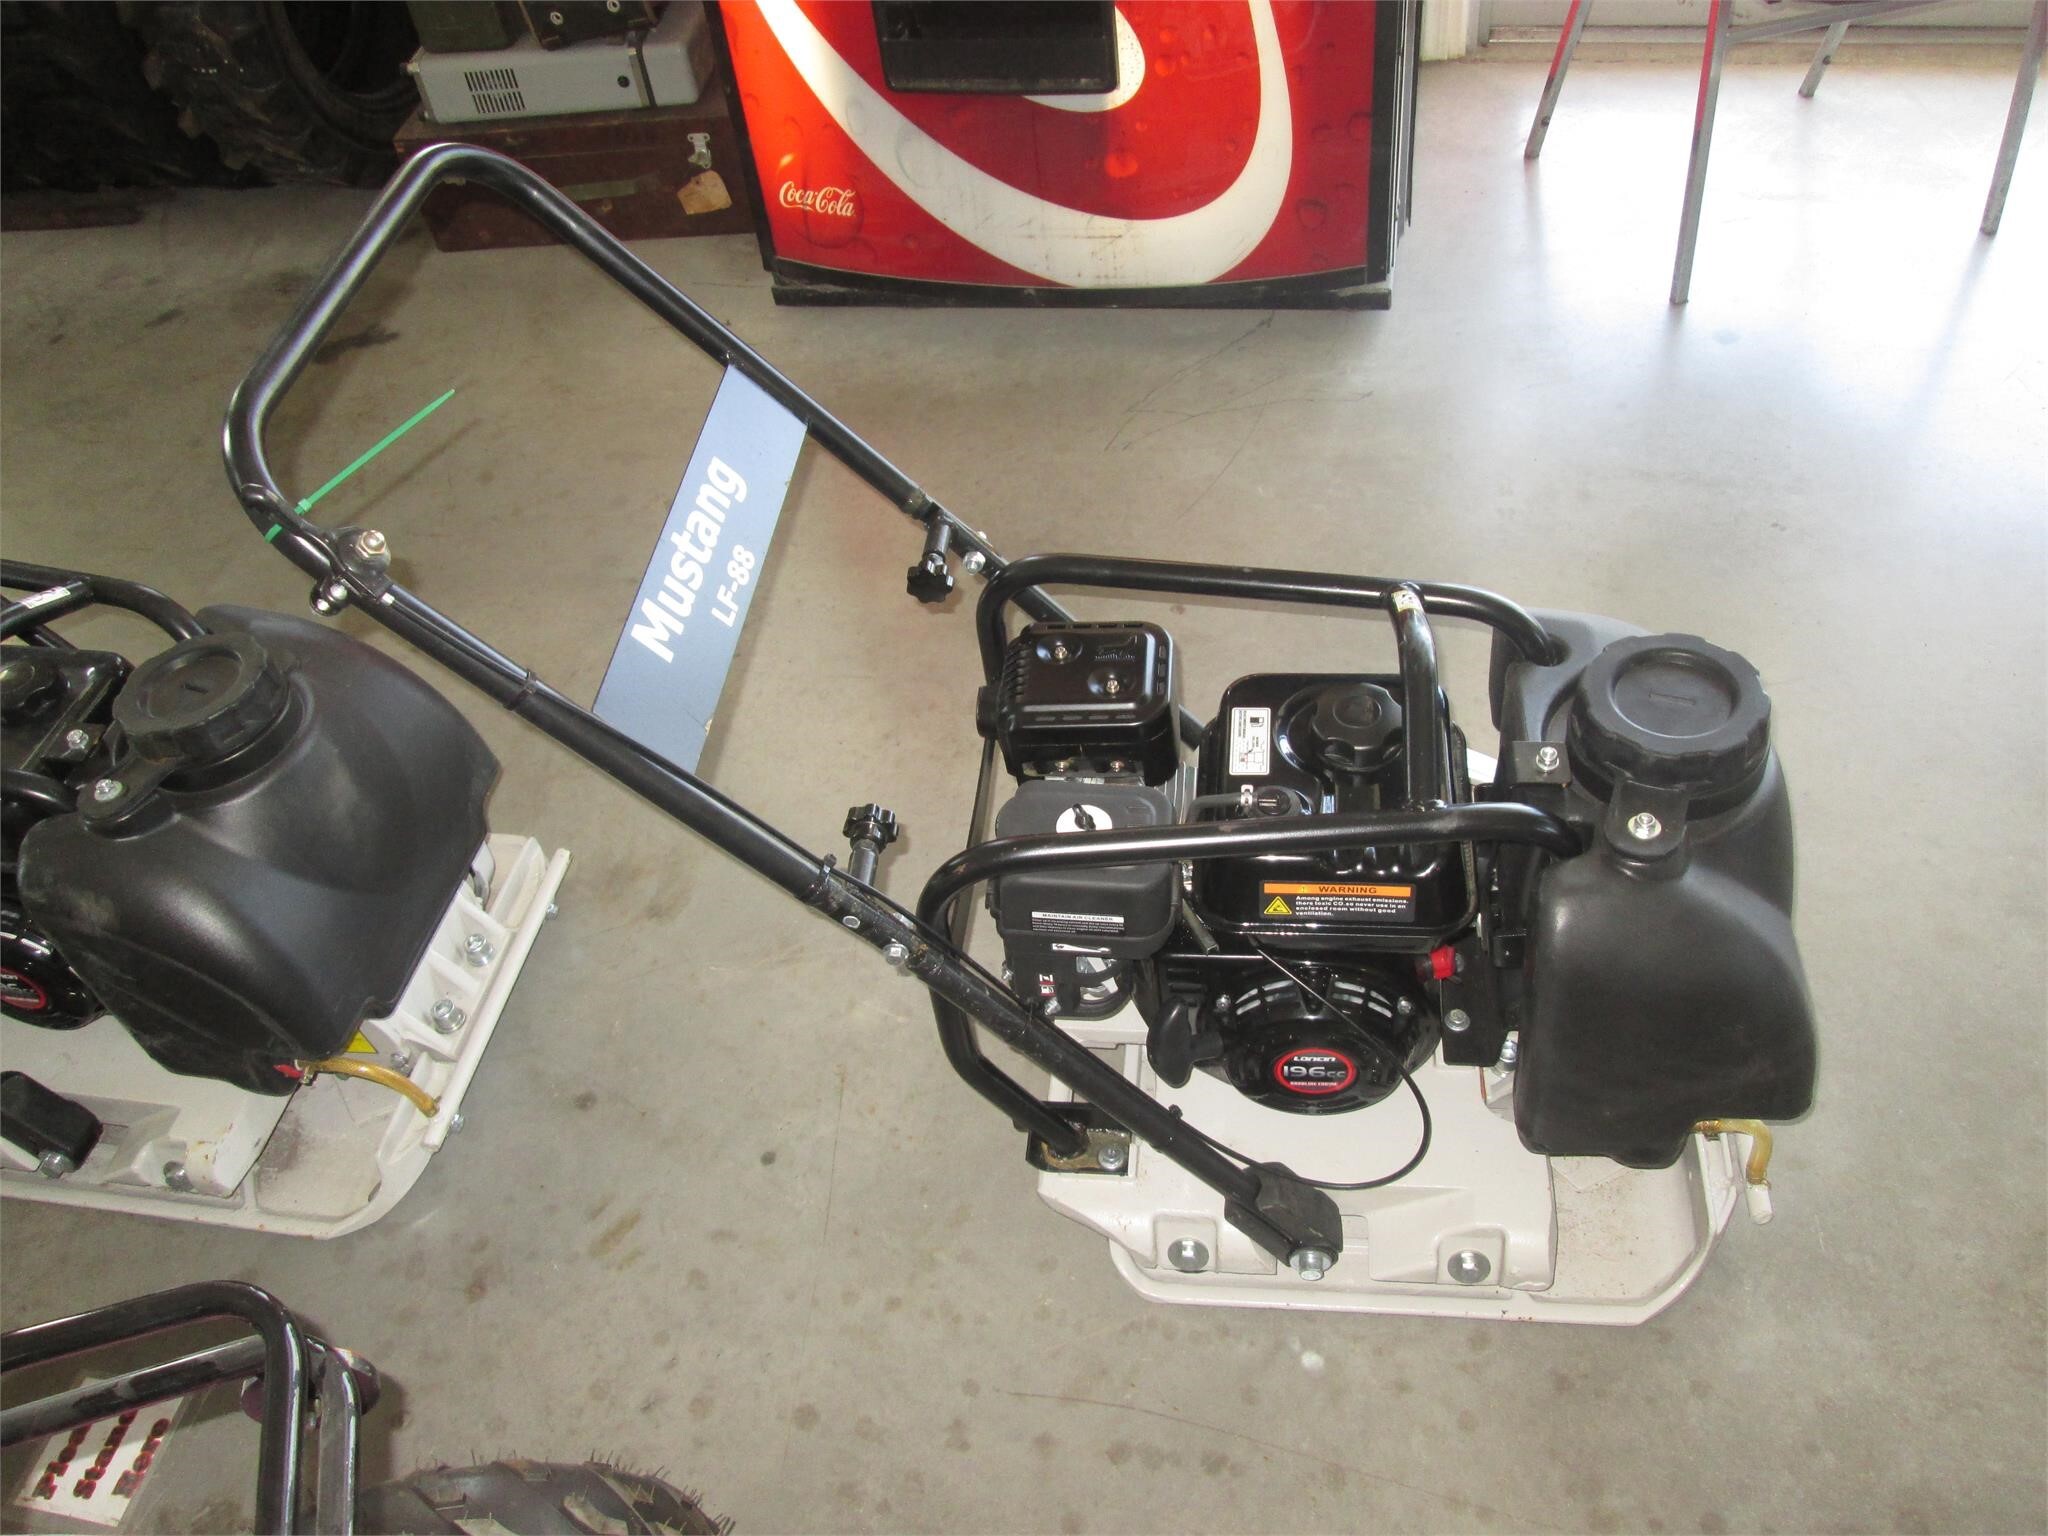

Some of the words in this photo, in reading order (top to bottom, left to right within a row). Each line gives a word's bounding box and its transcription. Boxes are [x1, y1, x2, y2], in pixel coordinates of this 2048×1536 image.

[779, 180, 856, 217] Coca-Cola
[631, 455, 748, 664] Mustang
[711, 544, 755, 628] LF-88
[1318, 886, 1377, 894] WARNING
[1283, 1065, 1346, 1078] 196cc
